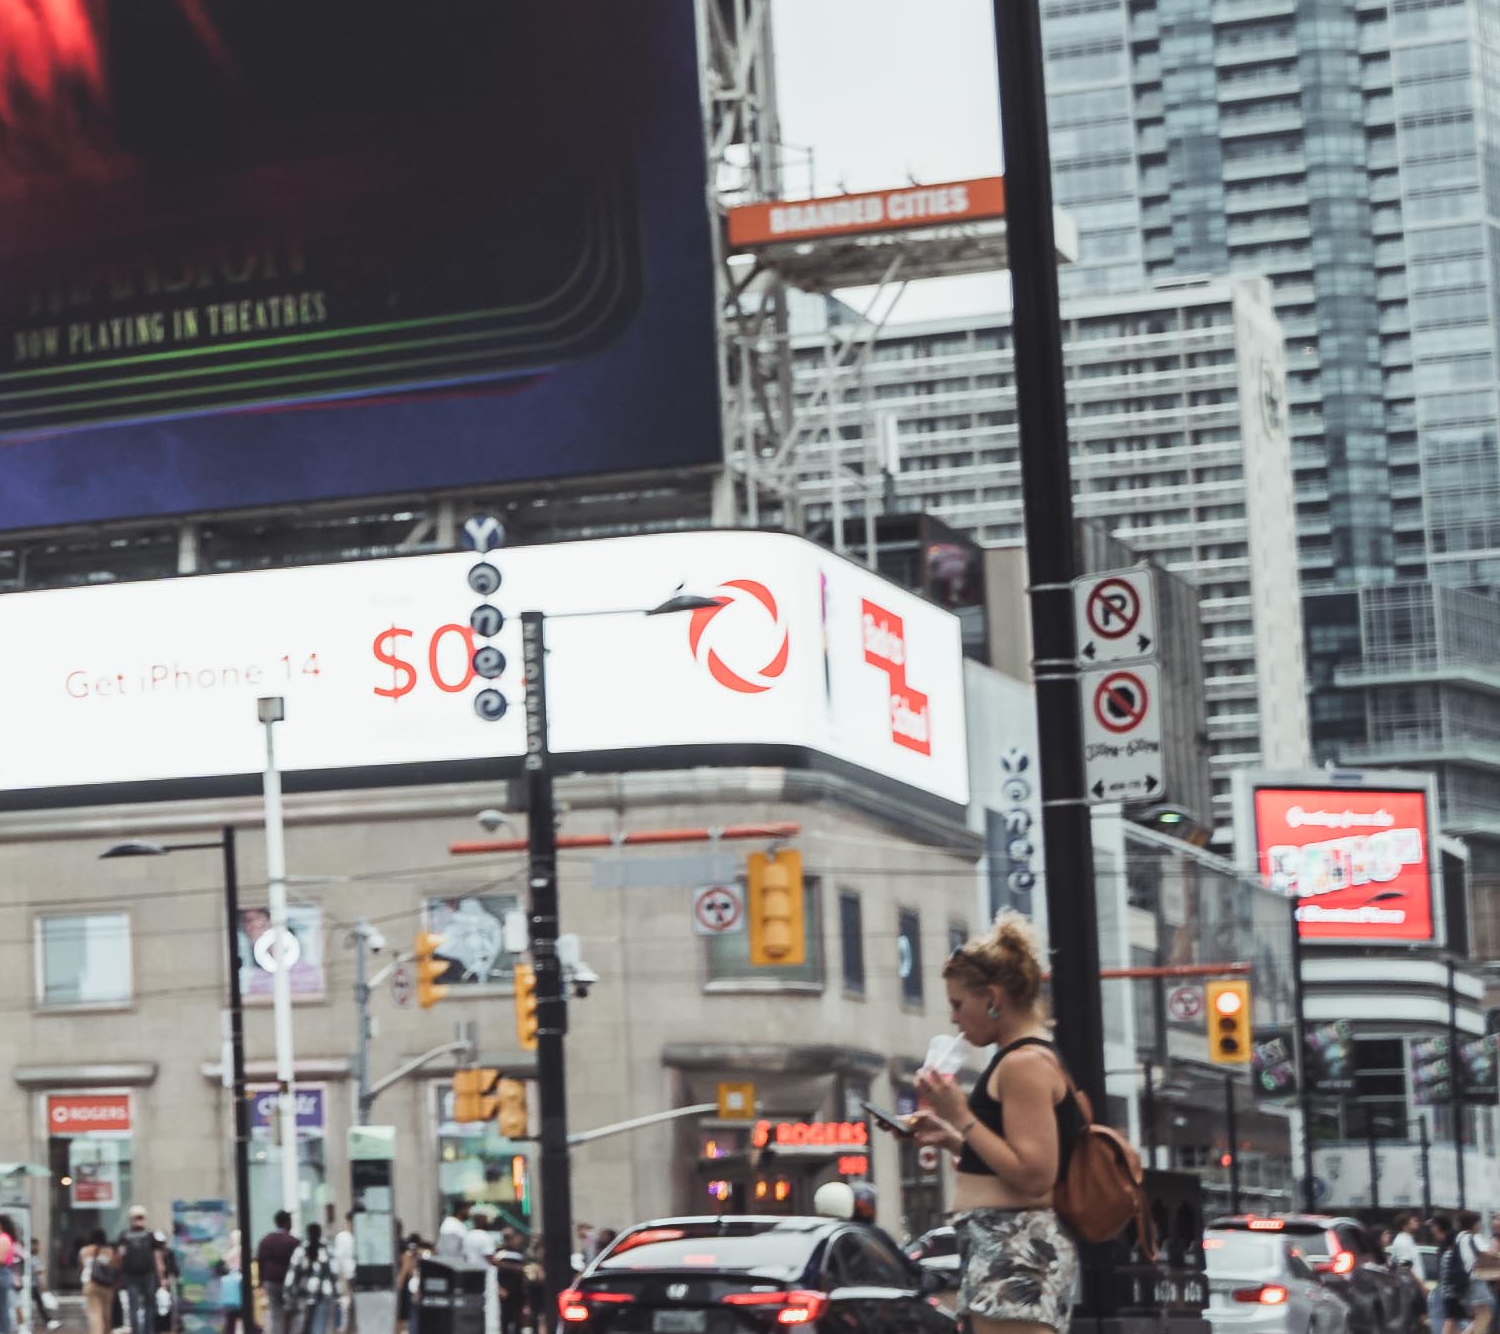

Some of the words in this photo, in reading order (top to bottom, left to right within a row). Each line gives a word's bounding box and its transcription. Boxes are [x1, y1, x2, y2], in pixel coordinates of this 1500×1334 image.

[68, 312, 164, 355] PLAYING
[172, 306, 198, 341] IN
[206, 290, 327, 336] THEATRES
[65, 669, 127, 699] Get
[140, 662, 264, 693] iPhone
[280, 653, 320, 680] 14
[70, 1105, 127, 1121] ROGERS
[776, 1122, 868, 1145] ROGERS
